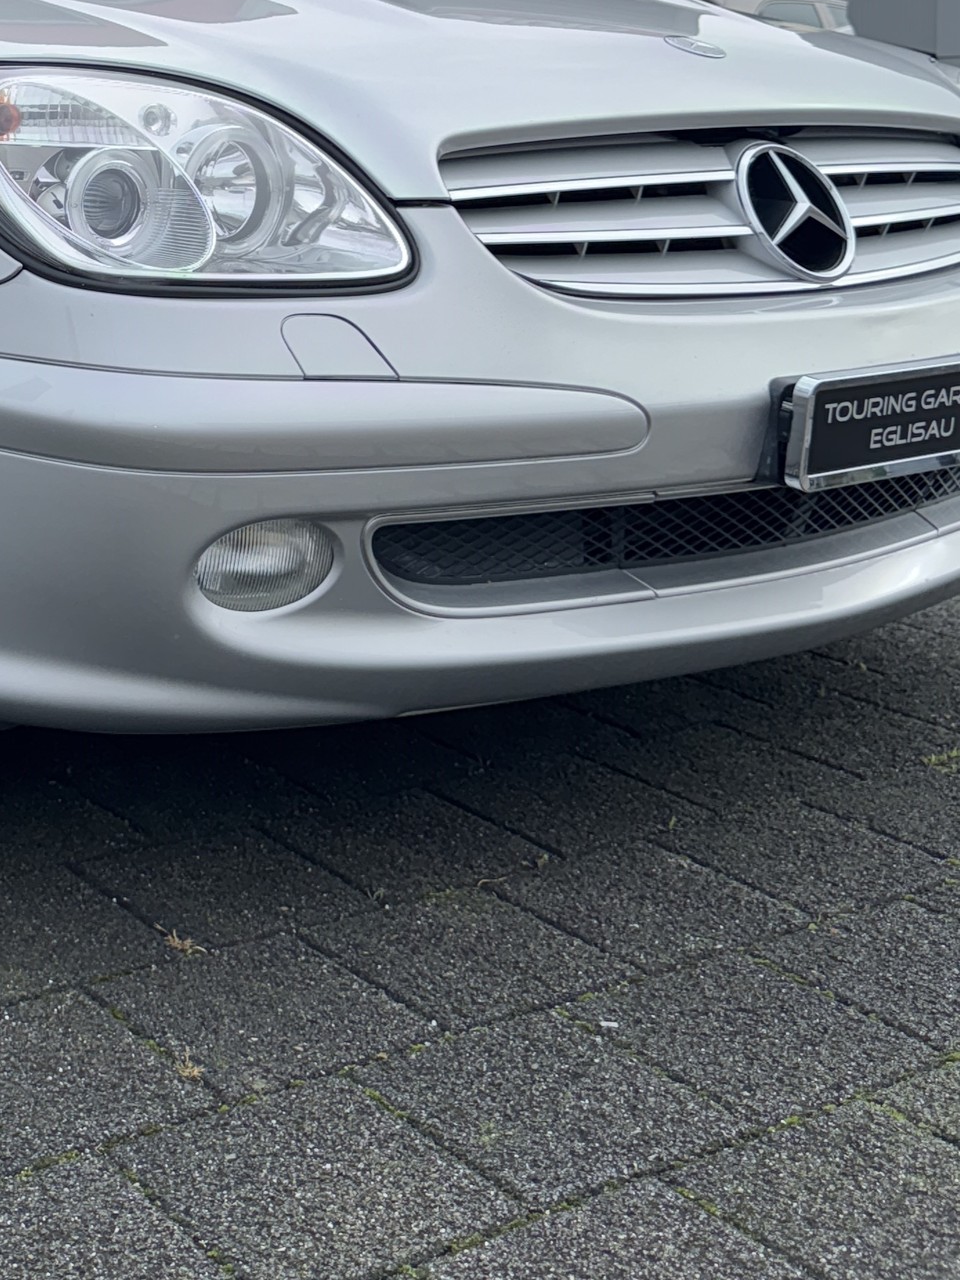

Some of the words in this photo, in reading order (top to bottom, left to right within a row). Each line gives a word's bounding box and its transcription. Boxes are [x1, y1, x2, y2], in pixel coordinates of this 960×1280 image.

[824, 392, 917, 423] TOURING
[920, 385, 960, 410] GAR
[869, 417, 955, 449] EGLISAU
